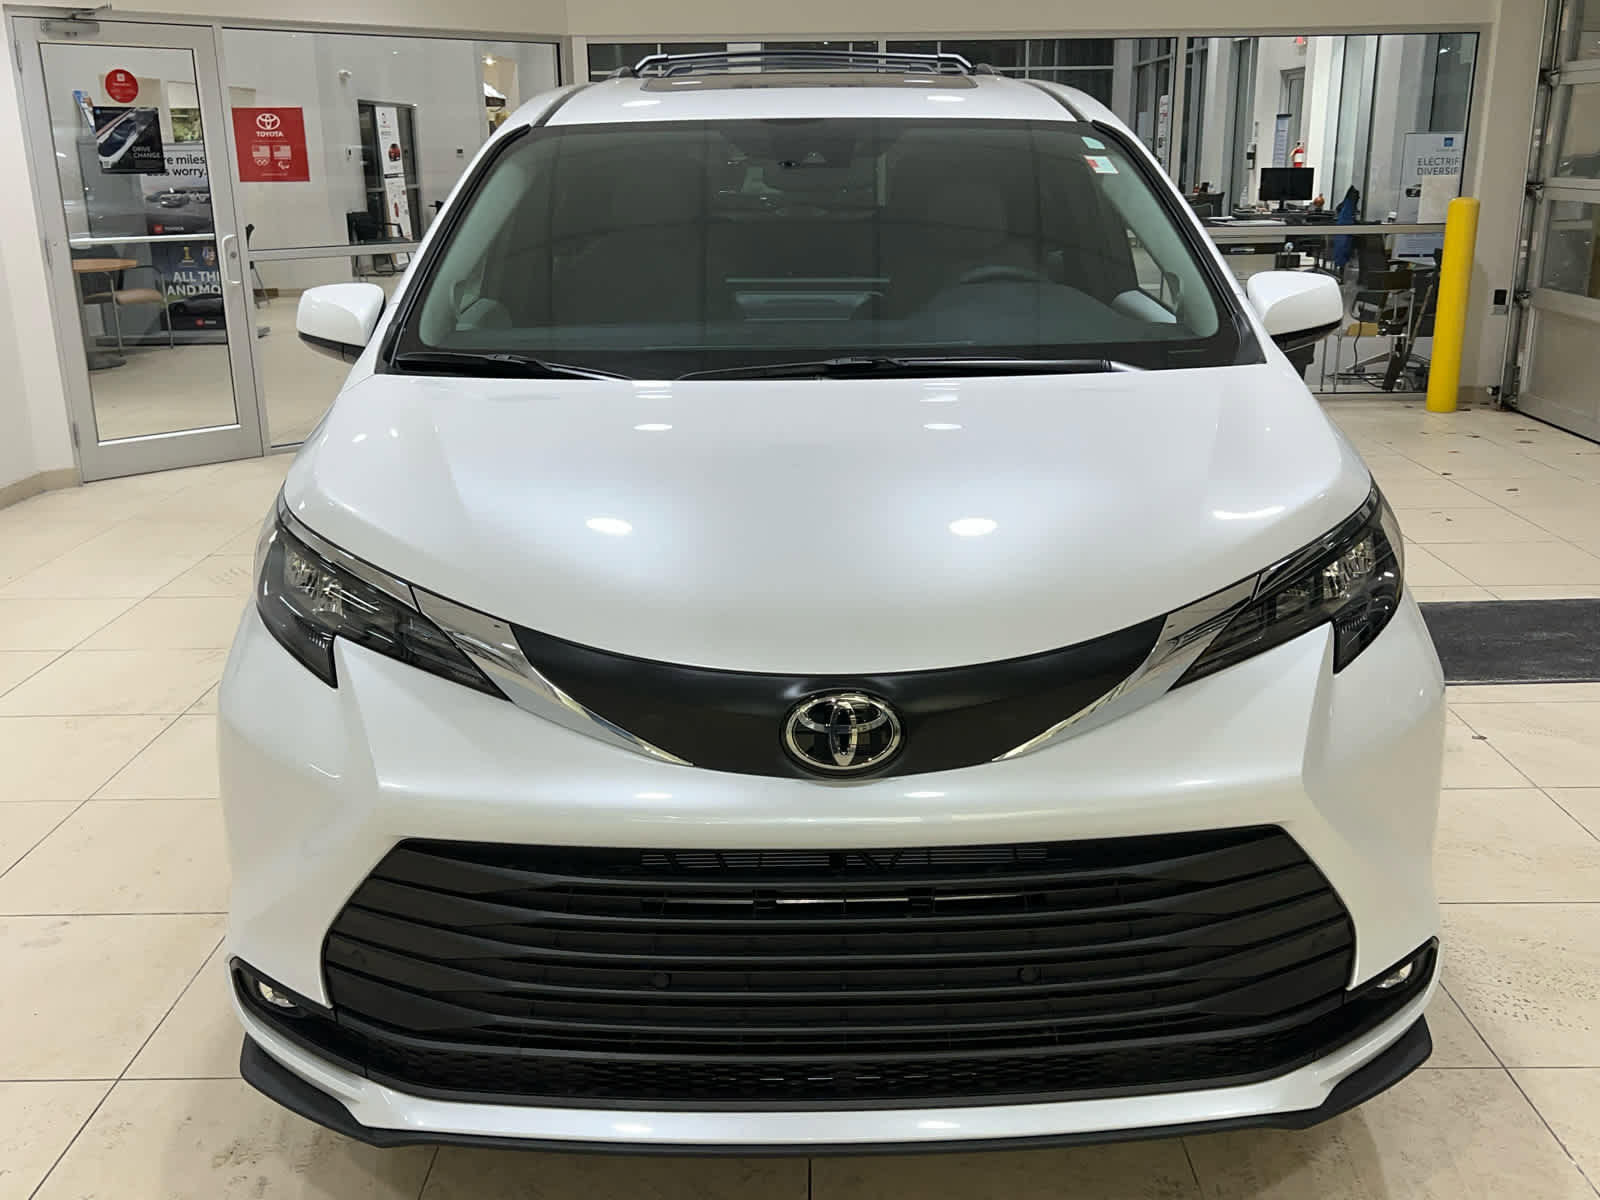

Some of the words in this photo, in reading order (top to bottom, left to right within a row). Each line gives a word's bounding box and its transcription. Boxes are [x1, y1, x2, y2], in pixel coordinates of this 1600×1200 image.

[1417, 157, 1460, 166] ELECTRIF
[1417, 167, 1459, 176] DIVERSIF
[173, 271, 196, 283] ALL
[198, 271, 220, 282] THI
[167, 285, 196, 296] AND
[199, 284, 222, 295] MO
